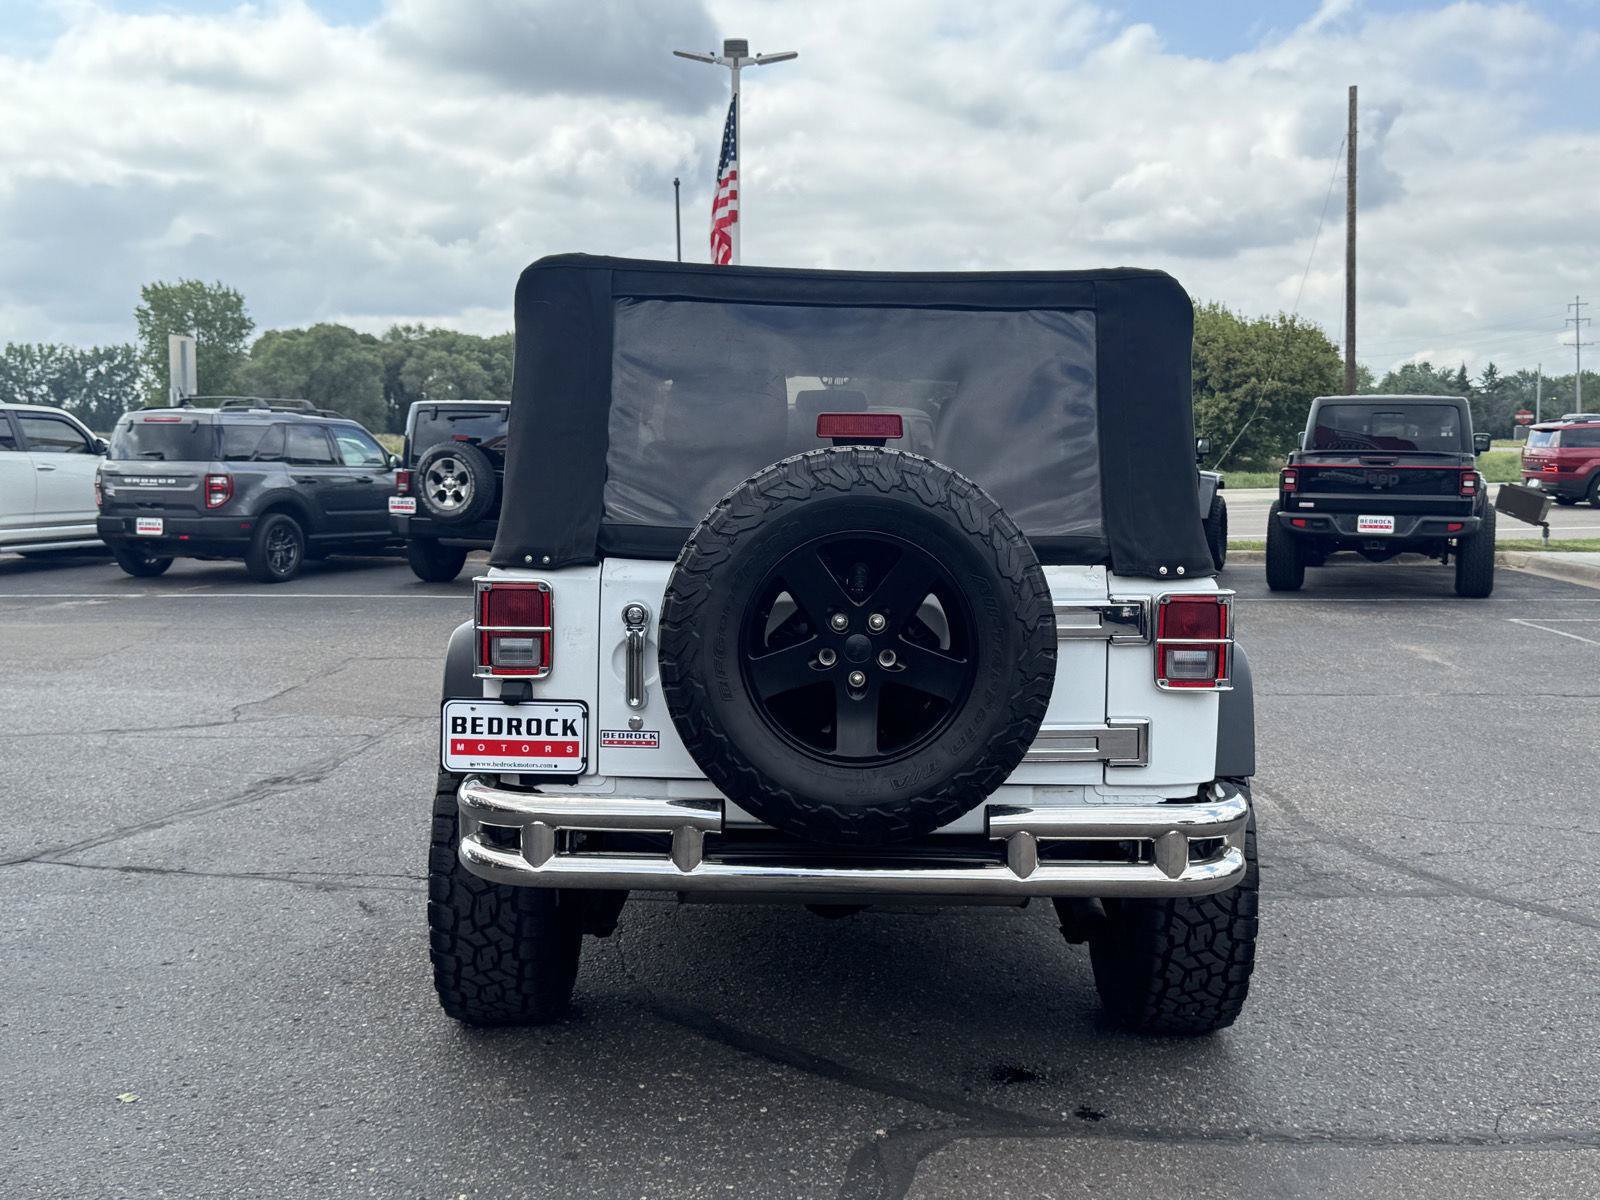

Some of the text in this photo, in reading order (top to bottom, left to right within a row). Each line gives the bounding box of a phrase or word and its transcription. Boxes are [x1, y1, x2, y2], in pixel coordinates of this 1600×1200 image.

[451, 716, 579, 737] BEDROCK
[603, 732, 656, 740] BEDROCK
[456, 743, 573, 753] MOTORS
[475, 761, 553, 769] www.bedrockmotors.com
